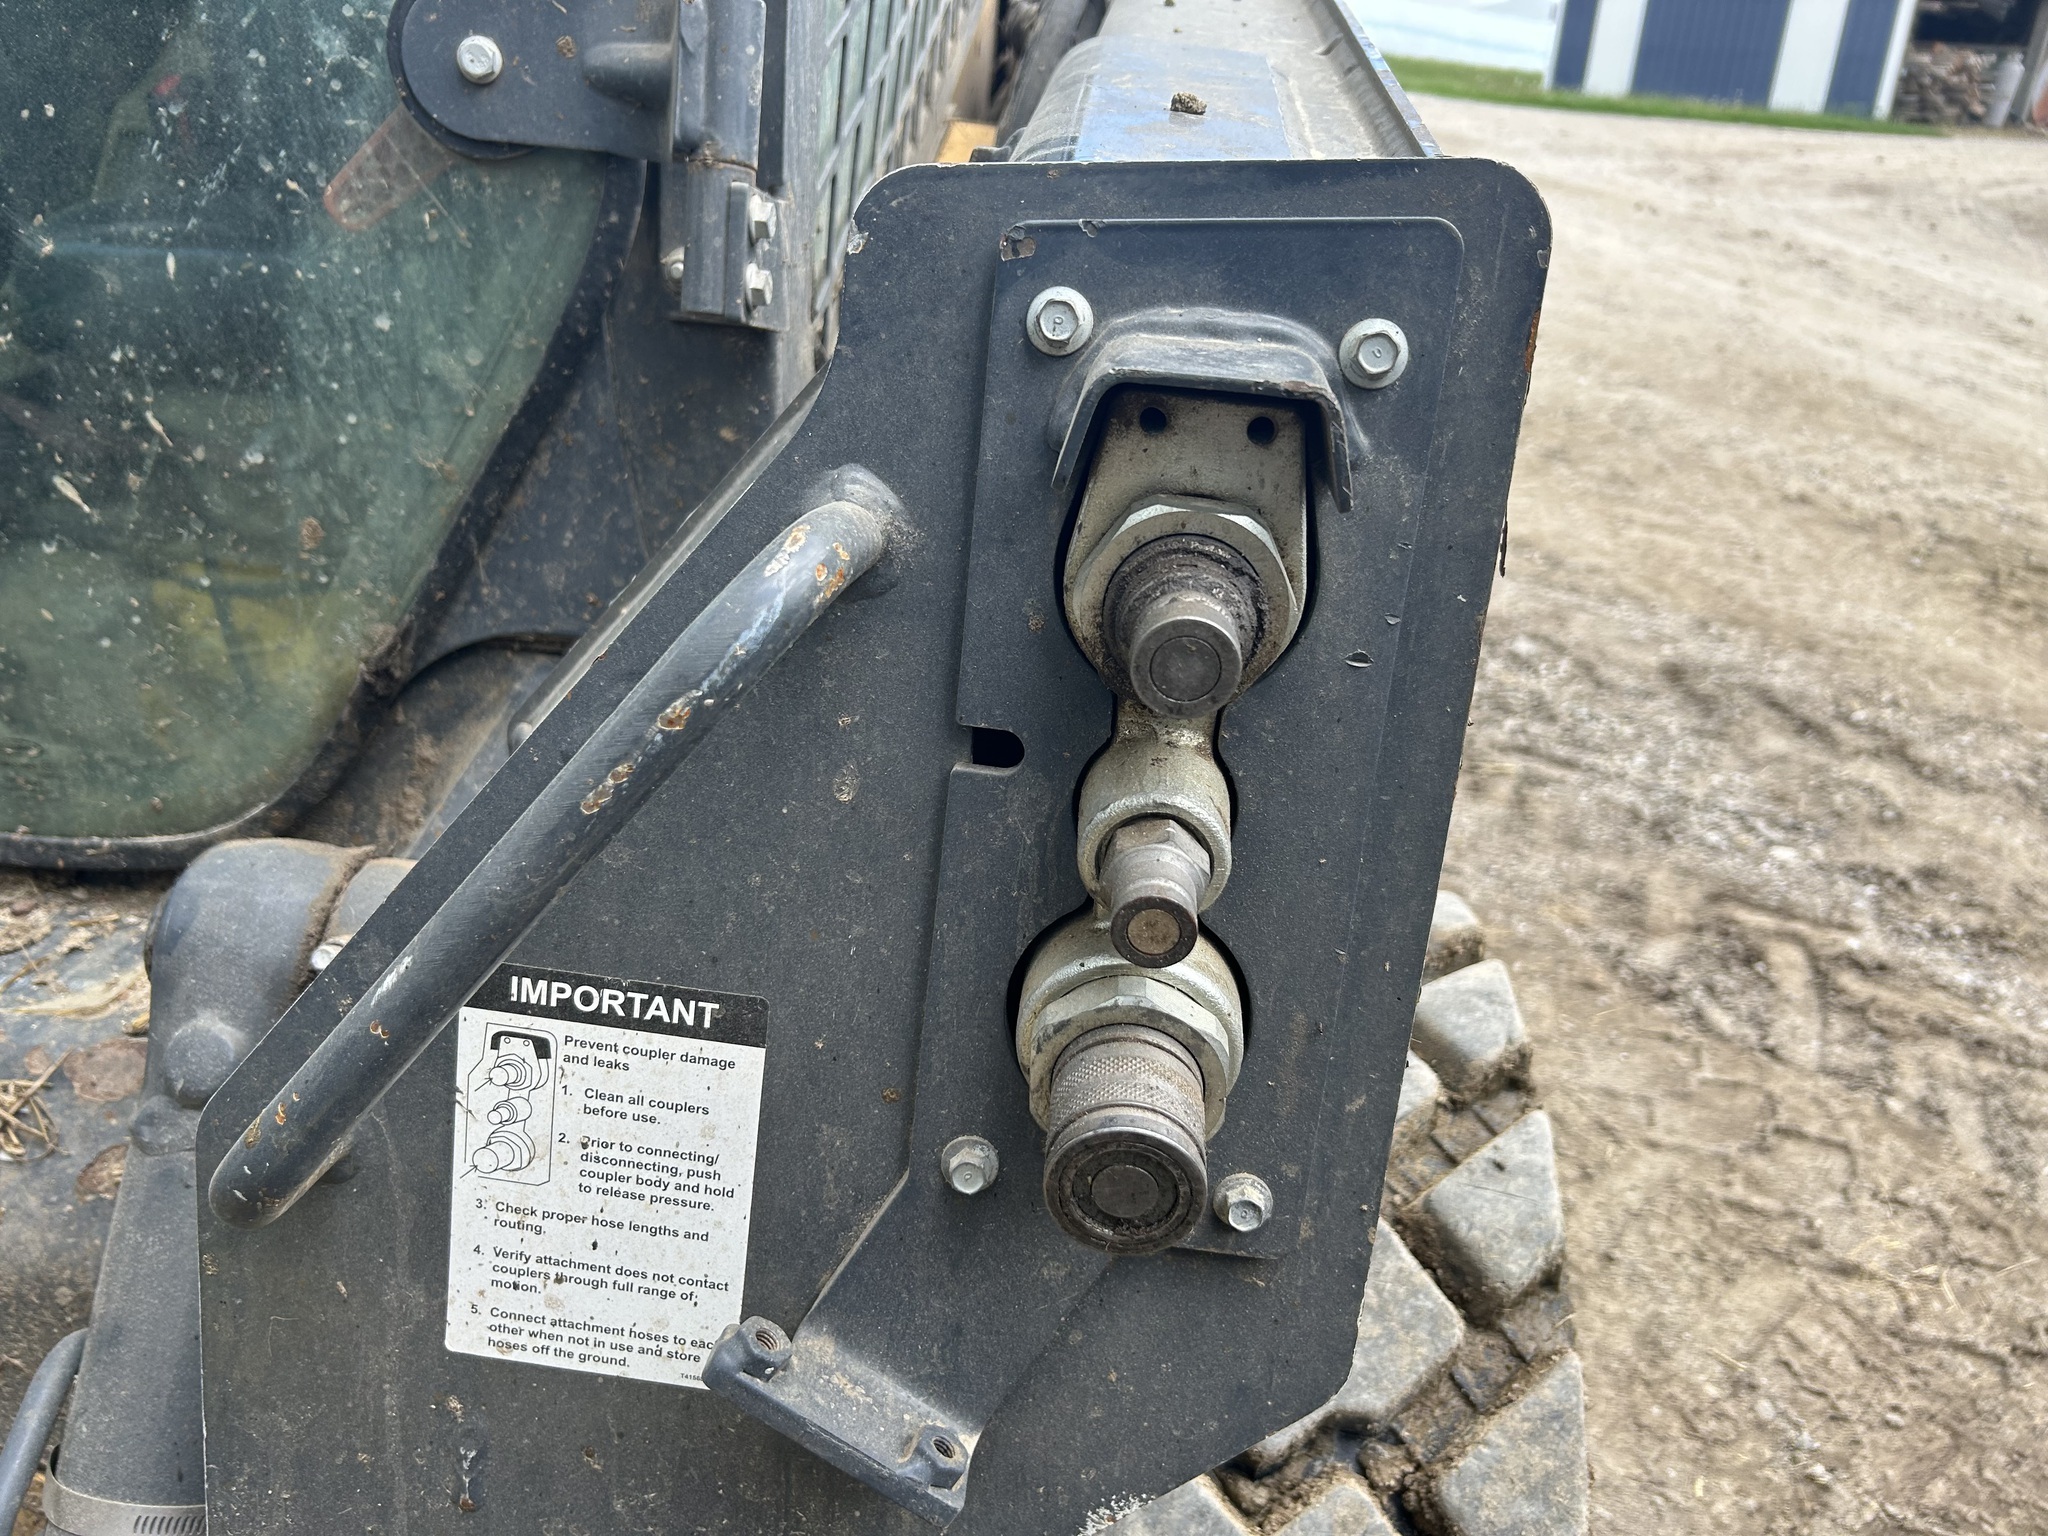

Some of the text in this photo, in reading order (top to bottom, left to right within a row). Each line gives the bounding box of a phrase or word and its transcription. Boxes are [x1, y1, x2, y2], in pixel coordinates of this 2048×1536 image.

[511, 975, 719, 1029] IMPORTANT
[563, 1053, 629, 1071] and leaks
[565, 1034, 735, 1071] Prevent coupler damage
[562, 1084, 709, 1115] 1. Clean all couplers
[584, 1103, 660, 1124] before use.
[558, 1131, 570, 1144] 2.
[619, 1141, 632, 1152] to
[636, 1145, 720, 1167] connecting/
[580, 1151, 721, 1181] disconnecting, push
[578, 1182, 714, 1211] to release pressure.
[579, 1168, 734, 1198] coupler body and hold
[494, 1219, 546, 1235] routing.
[496, 1200, 537, 1217] Check
[542, 1210, 587, 1224] proper
[592, 1214, 624, 1230] hose
[629, 1220, 679, 1237] lengths
[684, 1230, 709, 1242] and
[473, 1244, 728, 1291] 4. Verify attachment does not contact
[492, 1264, 550, 1280] couplers
[554, 1271, 608, 1290] through
[613, 1279, 633, 1292] full
[638, 1285, 676, 1300] range
[491, 1279, 541, 1294] motion.
[489, 1323, 700, 1363] other when not in use and store
[490, 1306, 545, 1324] Connect
[550, 1317, 624, 1336] attachment
[629, 1327, 669, 1343] hoses
[673, 1334, 686, 1346] to
[690, 1338, 714, 1350] eac
[488, 1336, 631, 1368] hoses off the ground.
